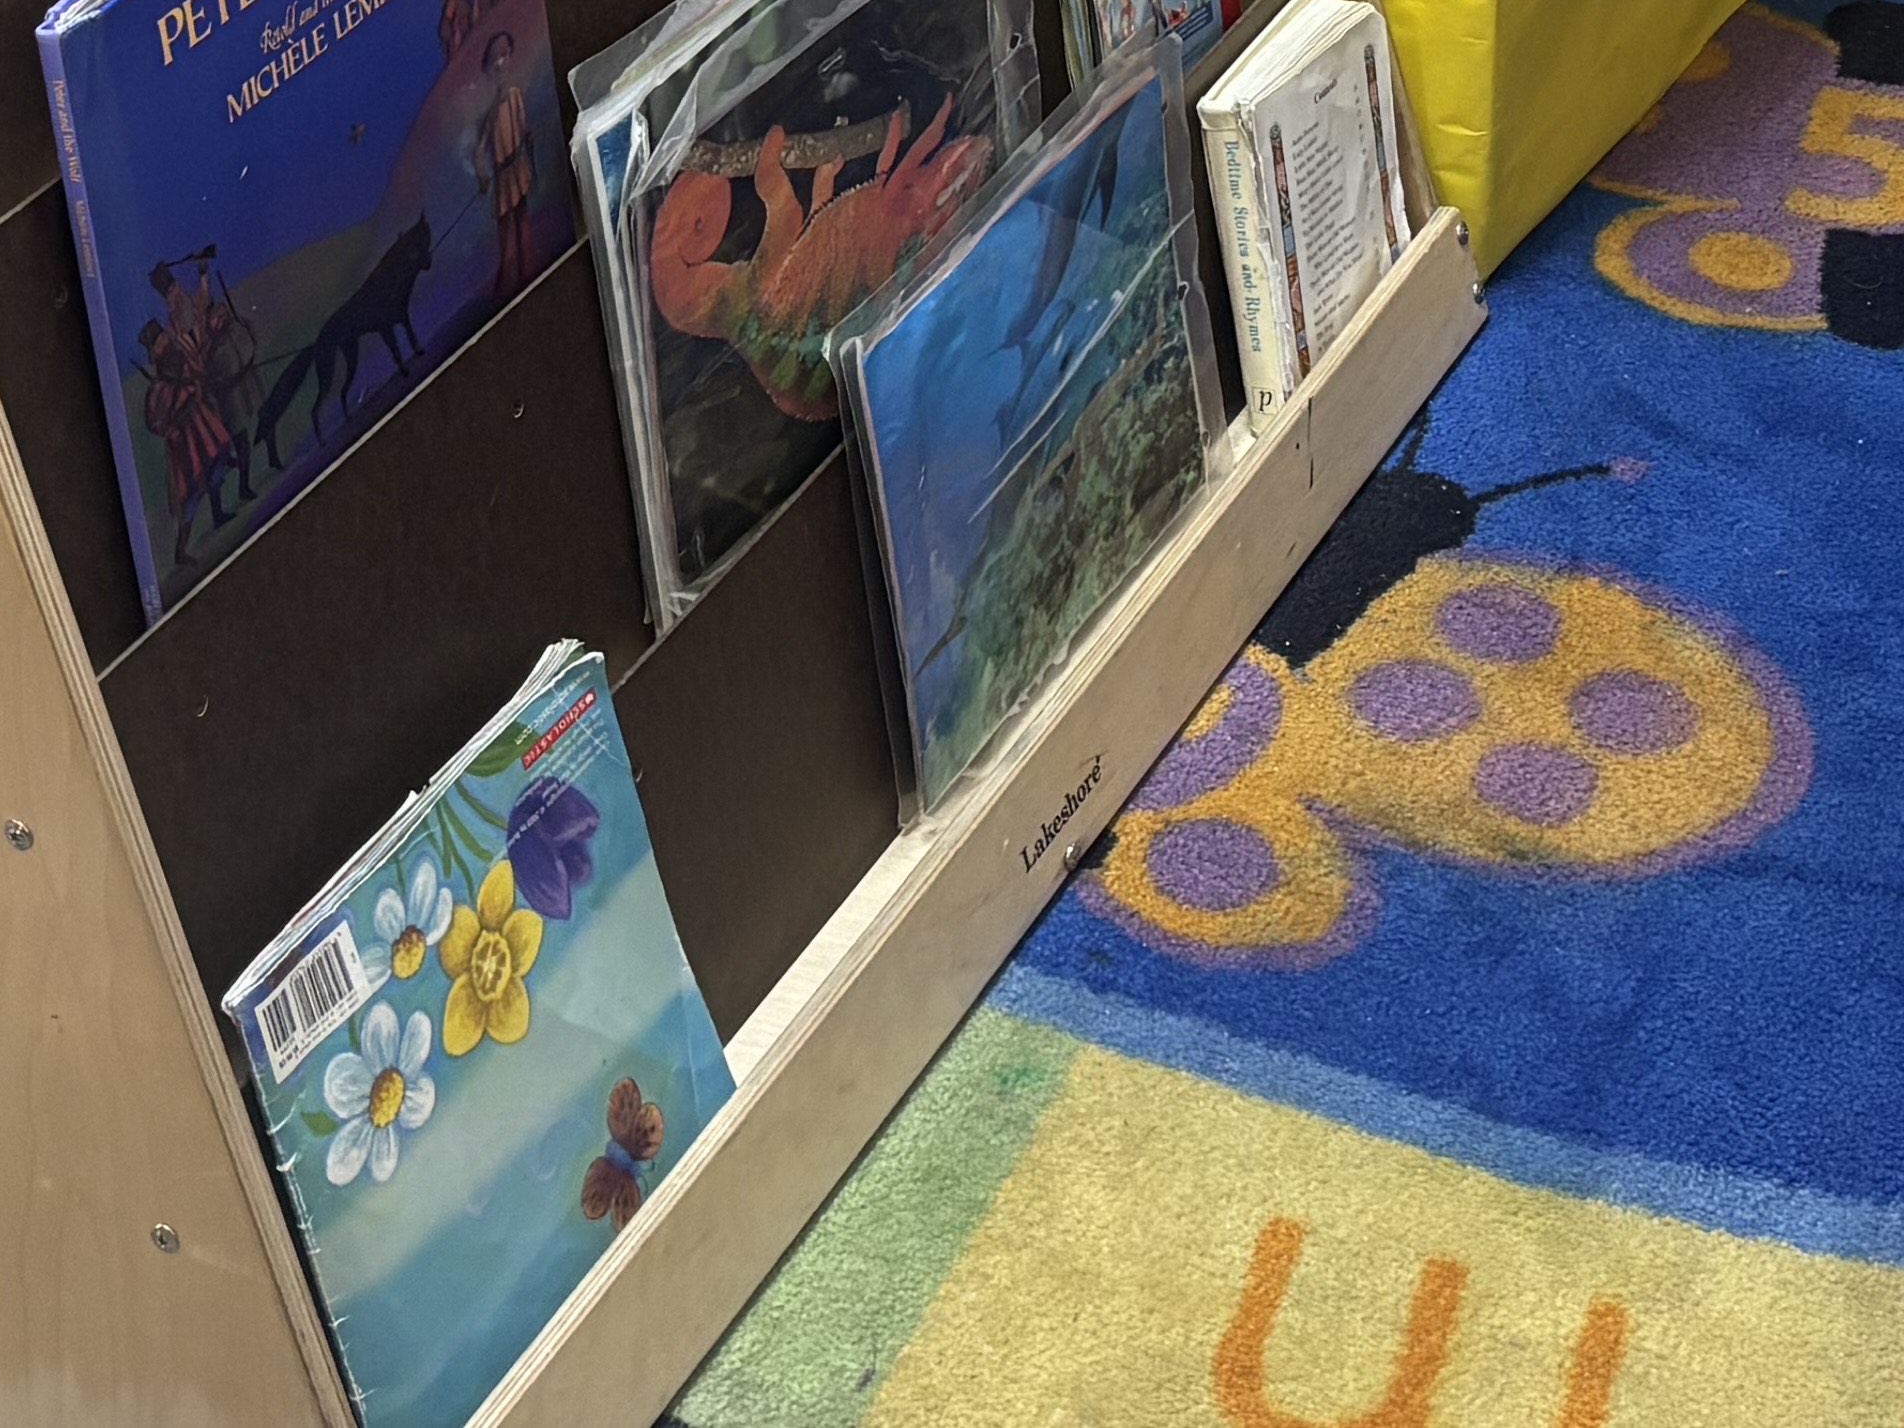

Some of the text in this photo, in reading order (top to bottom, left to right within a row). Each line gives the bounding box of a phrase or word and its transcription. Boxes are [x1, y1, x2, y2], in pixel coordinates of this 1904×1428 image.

[226, 22, 329, 124] MICHÈLE
[1224, 140, 1262, 354] Bedtime Stories and Rhymes
[523, 699, 586, 767] SCHOLASTIC
[1019, 760, 1102, 874] Lakeshore
